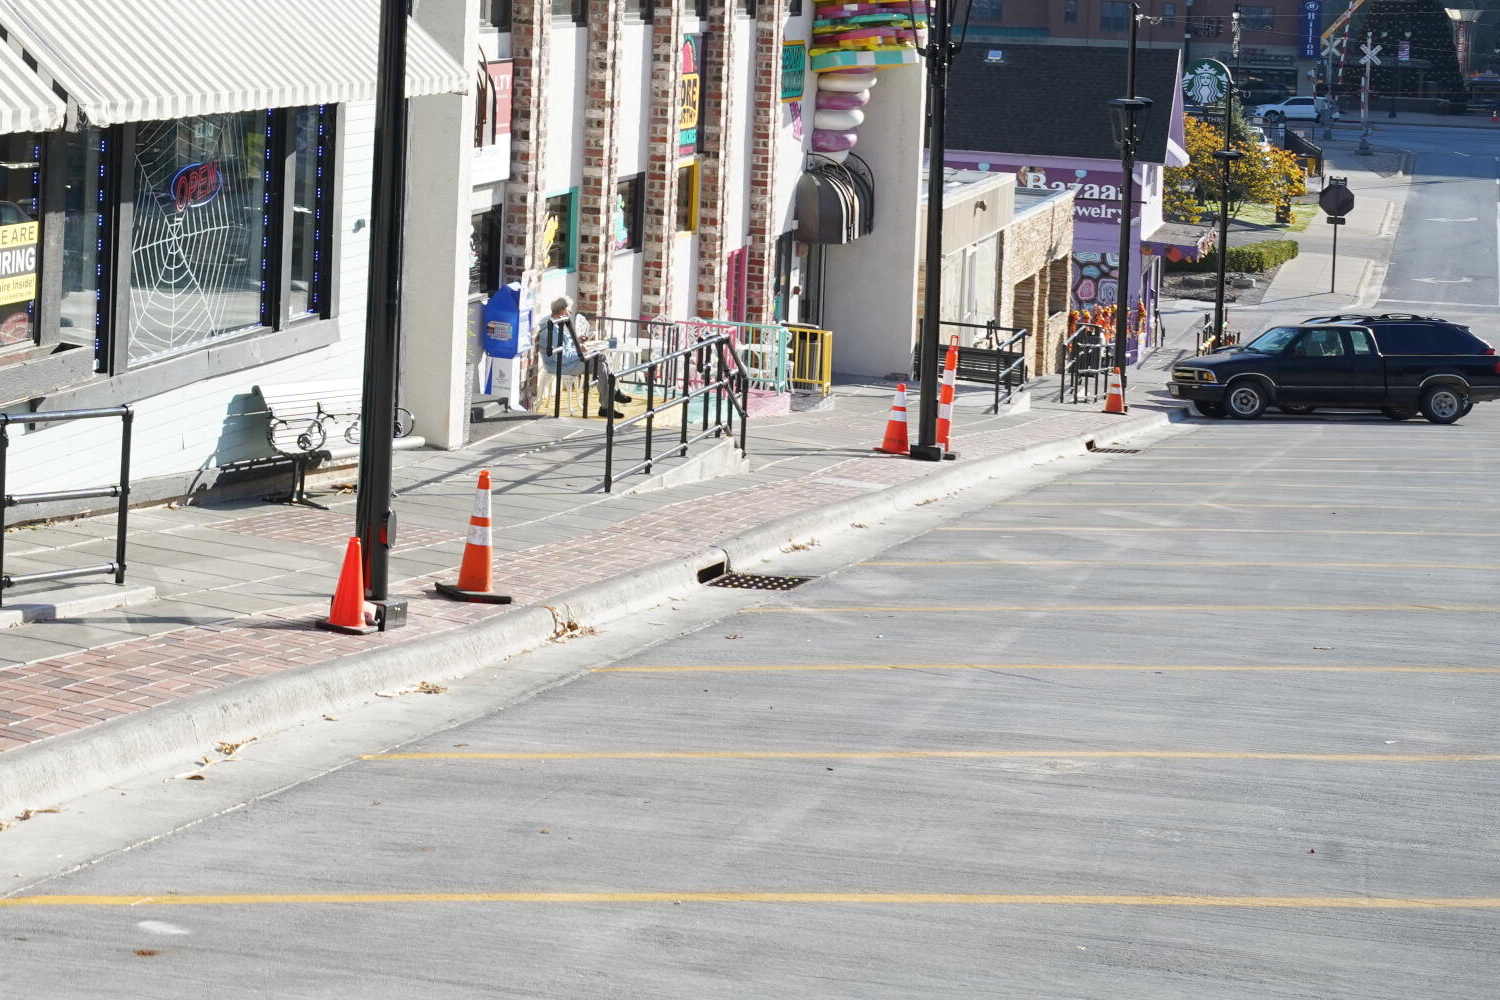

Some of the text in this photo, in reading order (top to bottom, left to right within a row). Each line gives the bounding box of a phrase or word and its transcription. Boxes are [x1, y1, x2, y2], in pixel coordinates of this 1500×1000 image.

[1306, 12, 1315, 56] Hilton
[176, 161, 217, 212] OPEN
[11, 226, 35, 241] ARE
[12, 277, 35, 290] Inside!
